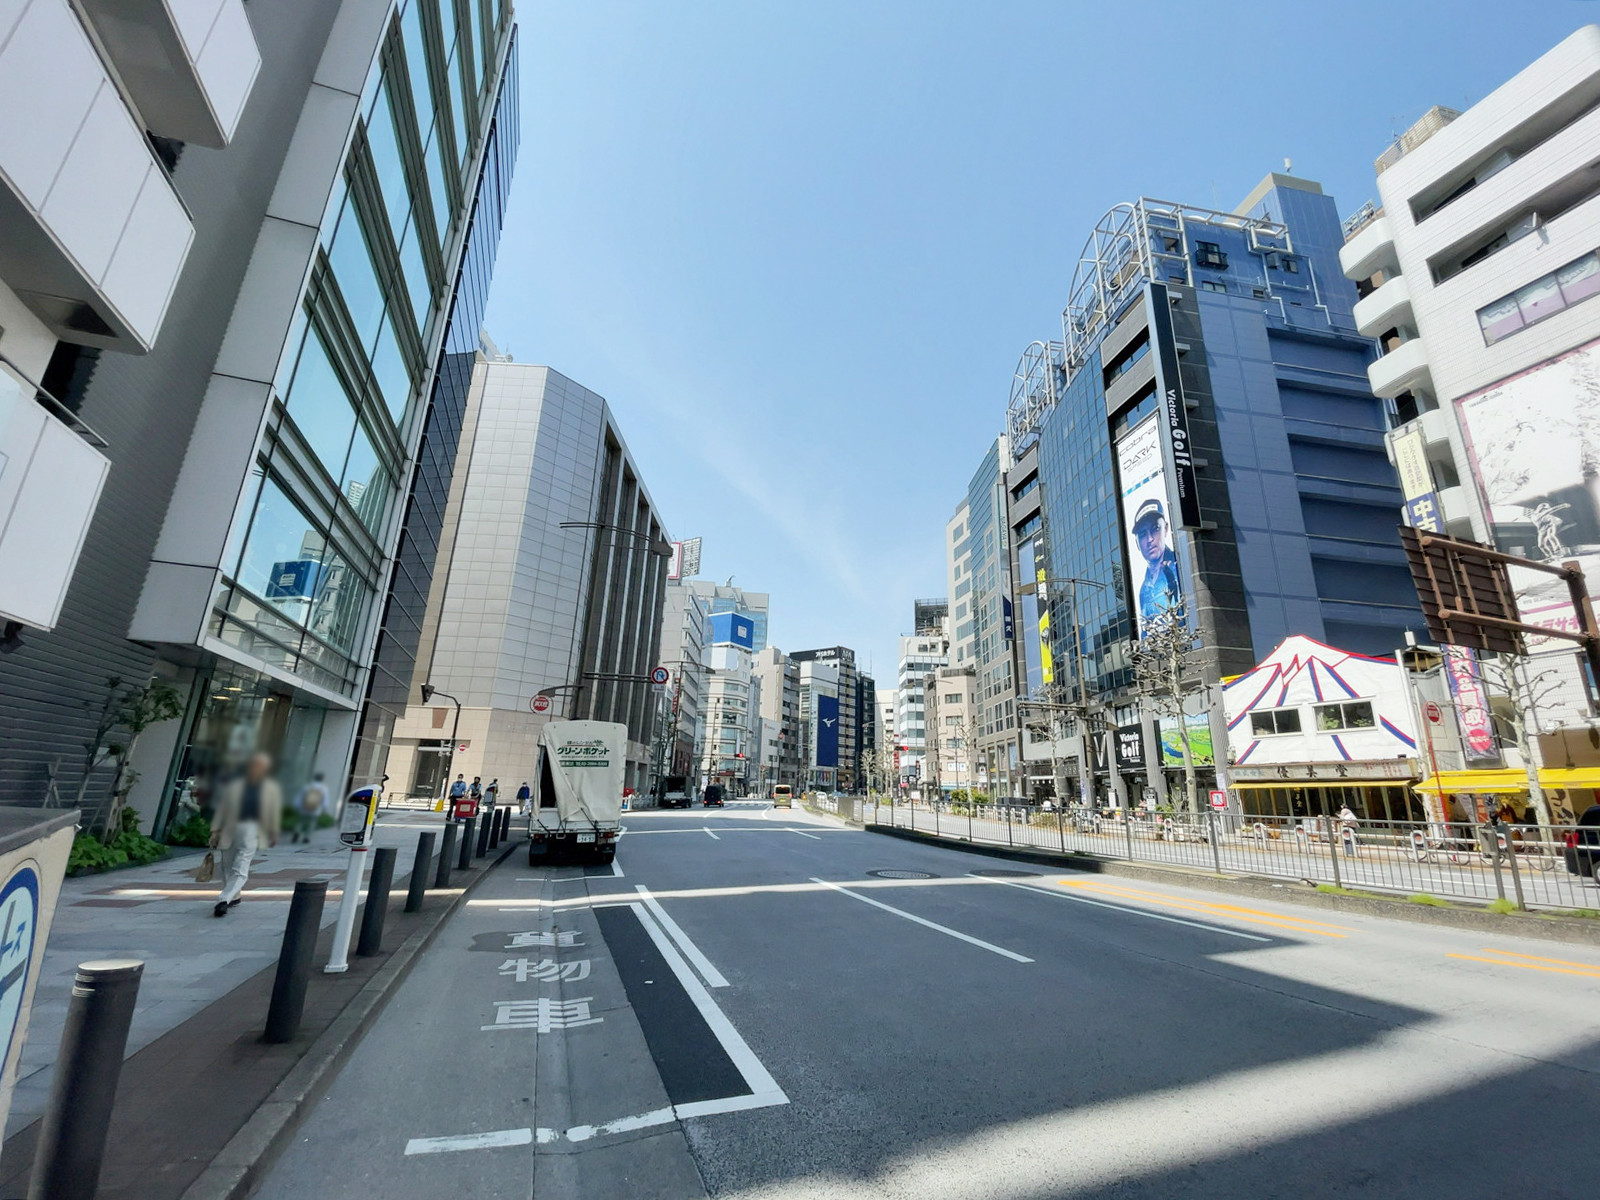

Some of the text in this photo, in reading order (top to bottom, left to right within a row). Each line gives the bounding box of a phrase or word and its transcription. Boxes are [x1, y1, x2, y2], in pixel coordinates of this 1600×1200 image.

[1119, 425, 1157, 457] cobra
[1167, 389, 1190, 498] Victoria Golf Premium
[1119, 731, 1140, 742] Victoria
[557, 747, 610, 755] グリーンポケット
[1121, 740, 1140, 758] Golf
